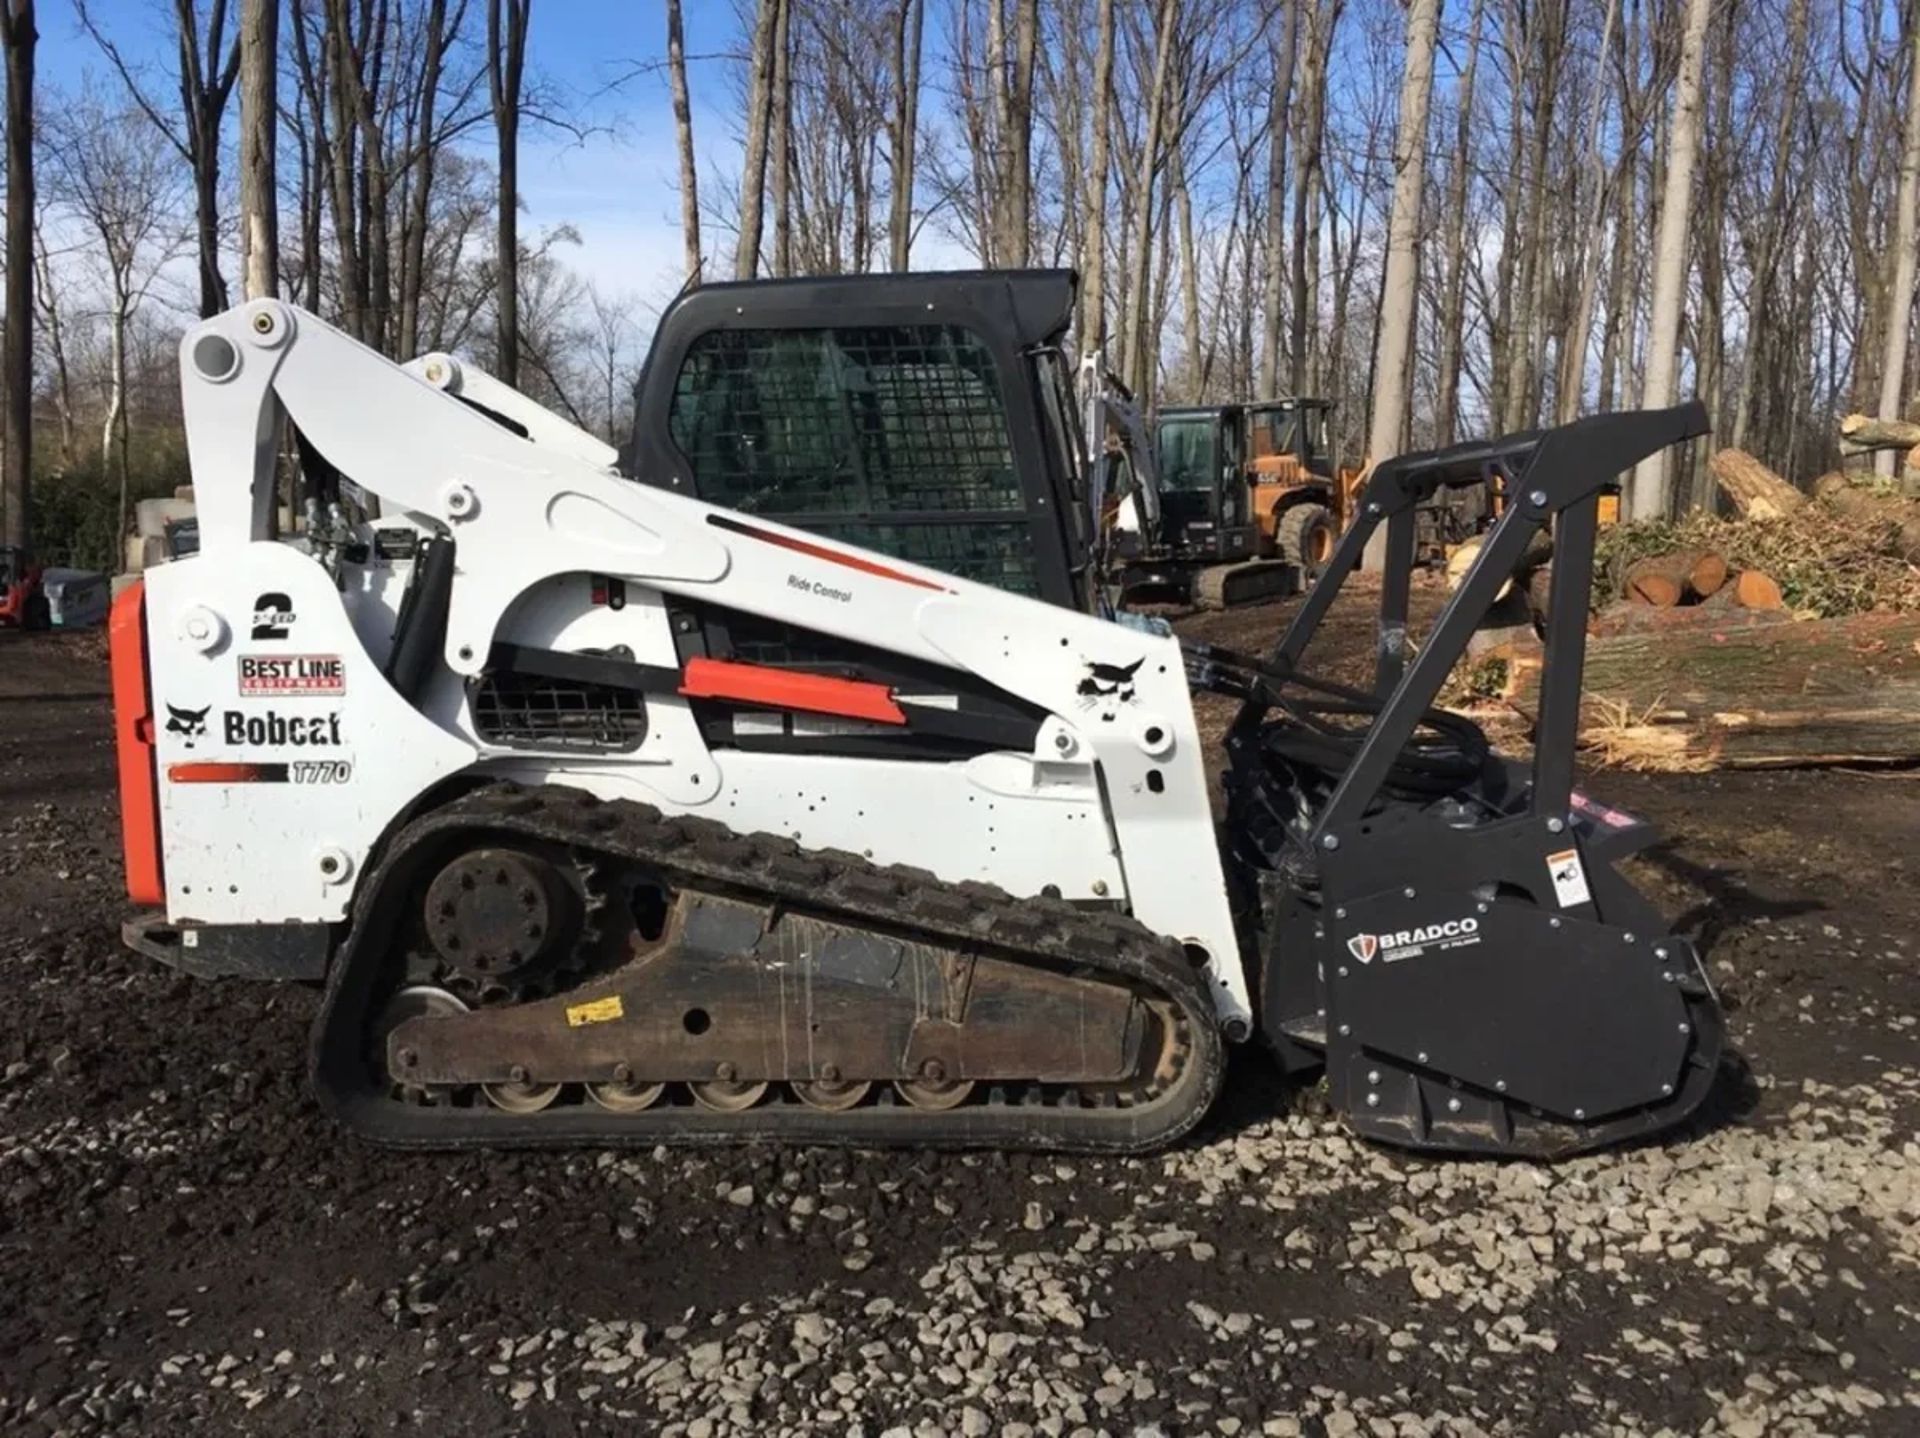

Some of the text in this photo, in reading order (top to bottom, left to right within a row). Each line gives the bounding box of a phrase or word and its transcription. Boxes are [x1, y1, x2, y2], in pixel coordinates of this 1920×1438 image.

[787, 574, 852, 602] Ride Control
[251, 592, 292, 640] 2
[242, 658, 342, 678] BEST LINE
[223, 711, 342, 746] Bobcat
[293, 761, 351, 783] T770
[1378, 917, 1479, 949] BRADCO
